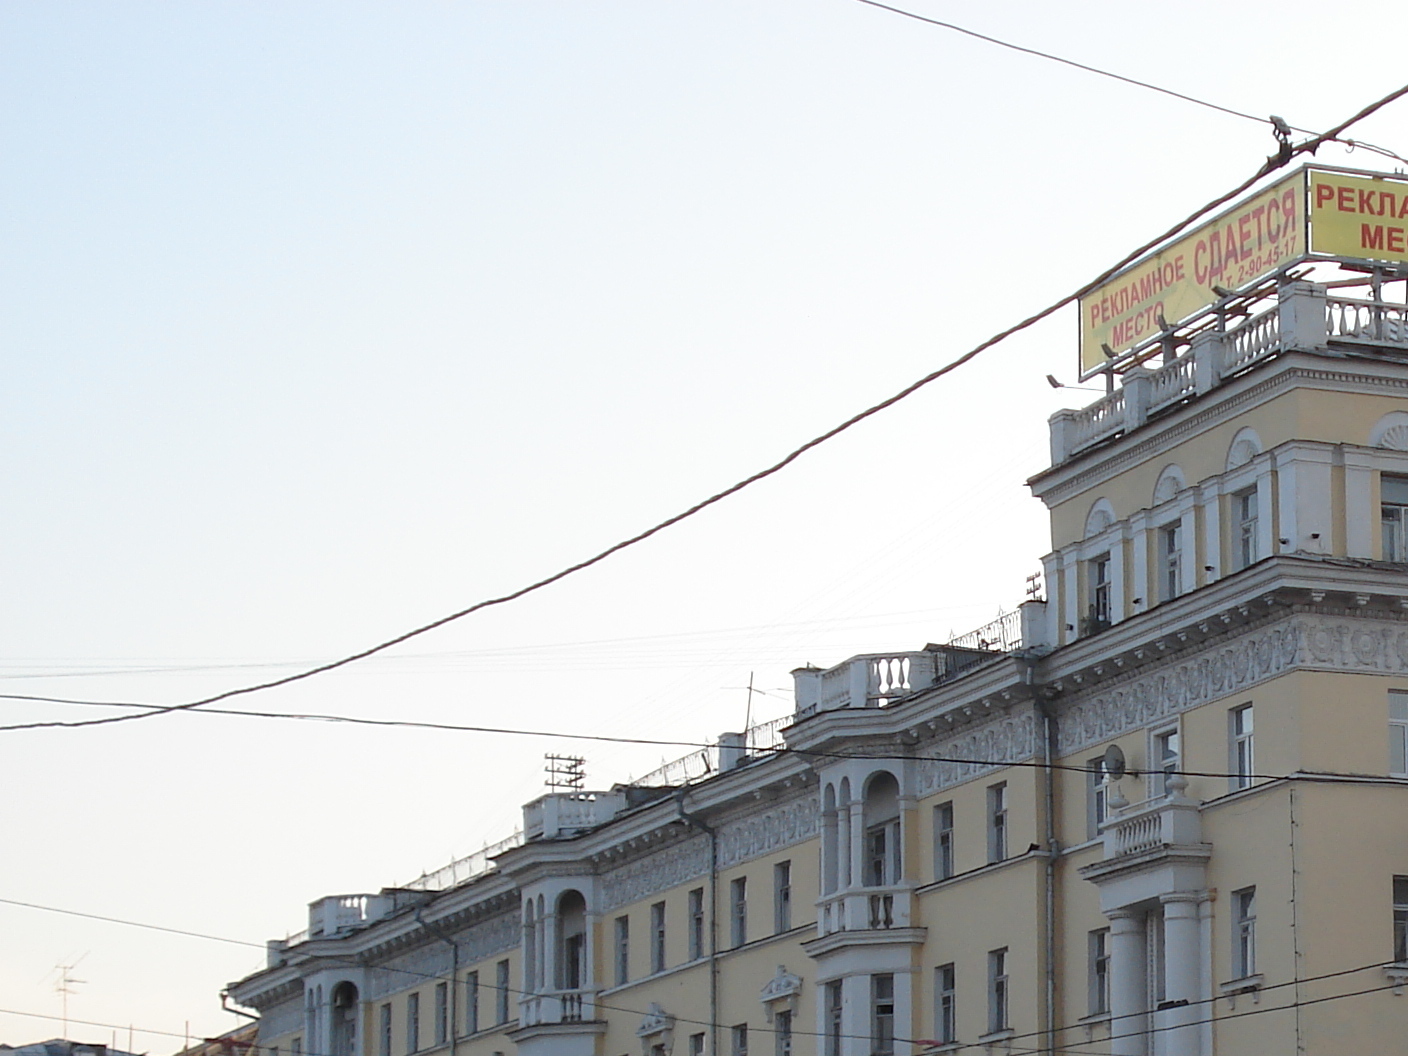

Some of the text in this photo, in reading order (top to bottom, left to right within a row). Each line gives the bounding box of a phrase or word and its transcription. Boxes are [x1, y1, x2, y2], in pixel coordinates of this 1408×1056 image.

[1194, 187, 1296, 288] СДАЕТСЯ
[1238, 235, 1297, 282] 2-90-45-17
[1090, 254, 1185, 329] РЕКЛАМНОЕ
[1112, 301, 1165, 349] МЕСТО
